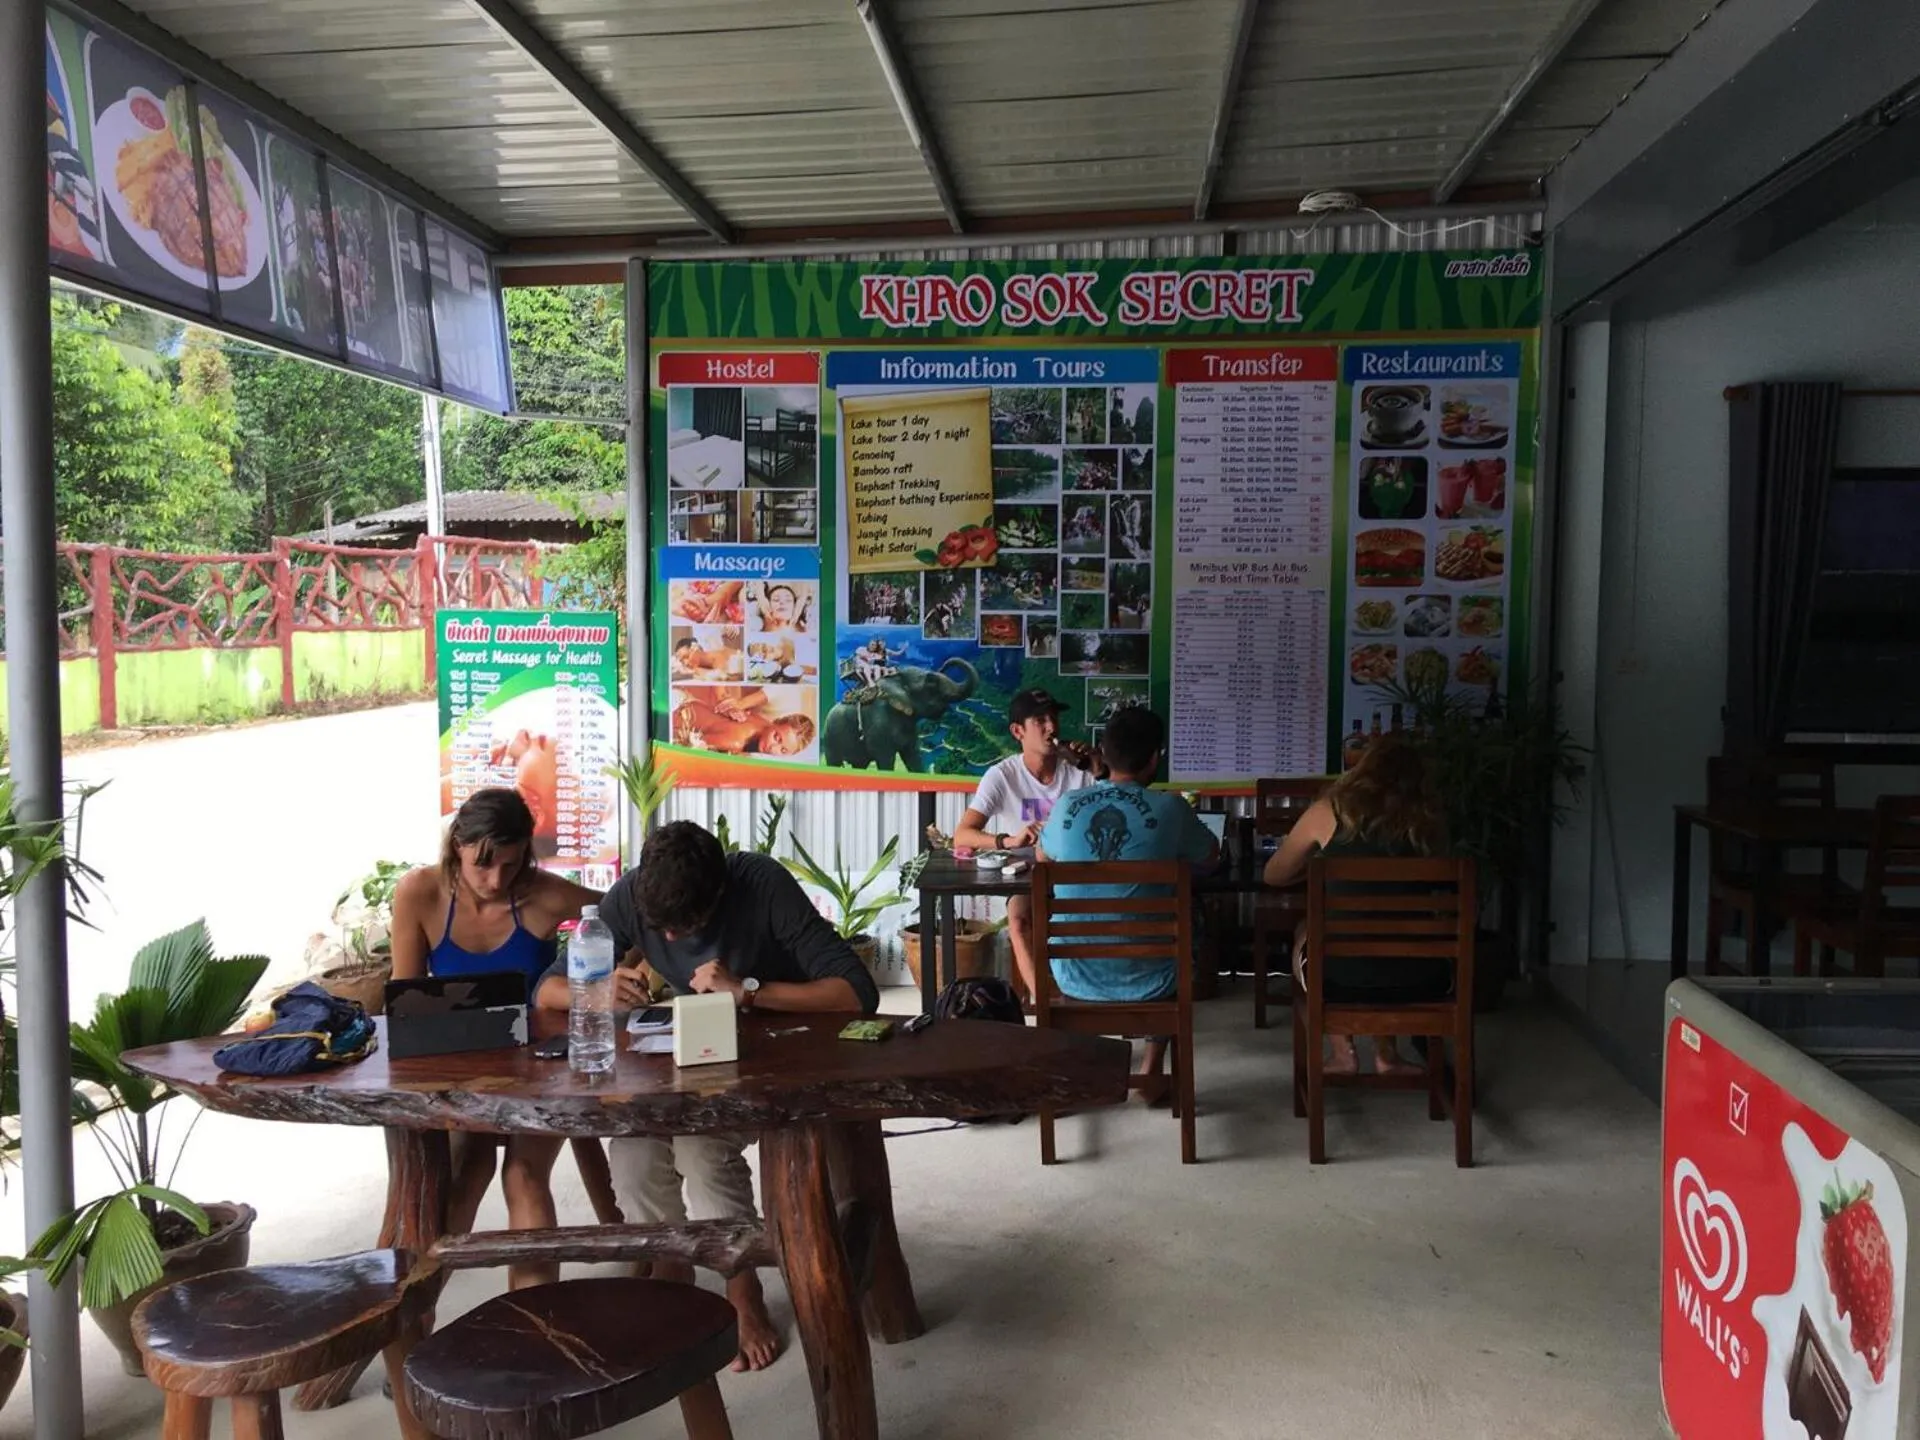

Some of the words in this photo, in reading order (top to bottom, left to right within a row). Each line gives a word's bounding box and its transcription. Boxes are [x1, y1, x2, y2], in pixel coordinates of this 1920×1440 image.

[861, 274, 996, 328] KHAO
[1002, 271, 1107, 326] SOK
[1120, 268, 1314, 324] SECRET
[706, 359, 774, 379] Hostel
[881, 357, 1017, 379] Information
[1032, 357, 1106, 379] Tours
[1202, 353, 1303, 377] Transfer
[1361, 350, 1504, 375] Restaurants
[851, 418, 873, 430] Lake
[876, 416, 897, 429] tour
[901, 416, 907, 427] 1
[911, 414, 930, 428] day
[852, 434, 873, 446] Lake
[877, 432, 897, 443] tour
[901, 432, 909, 442] 2
[912, 430, 930, 443] day
[934, 429, 940, 440] 1
[944, 427, 970, 442] night
[852, 450, 895, 462] Canoeing
[853, 466, 890, 477] Bamboo
[893, 463, 913, 475] raft
[855, 481, 895, 495] Elephant
[899, 479, 940, 491] Trekking
[855, 497, 895, 510] Elephant
[899, 495, 935, 507] bathing
[939, 490, 991, 504] Experience
[856, 513, 888, 525] Tubing
[857, 529, 888, 541] Jungle
[892, 525, 933, 539] Trekking
[858, 543, 885, 556] Night
[888, 542, 917, 554] Safari
[694, 552, 785, 578] Massage
[1190, 563, 1228, 572] Minibus
[1232, 563, 1248, 572] VIP
[1251, 563, 1269, 572] Bus
[1272, 563, 1287, 572] Air
[1291, 563, 1309, 573] Bus
[1198, 574, 1216, 584] and
[1246, 574, 1270, 584] Time
[1274, 574, 1300, 584] Table
[452, 649, 489, 664] Secret
[492, 650, 541, 667] Massage
[546, 650, 562, 665] for
[565, 651, 603, 665] Health
[1674, 1267, 1742, 1380] WALL'S
